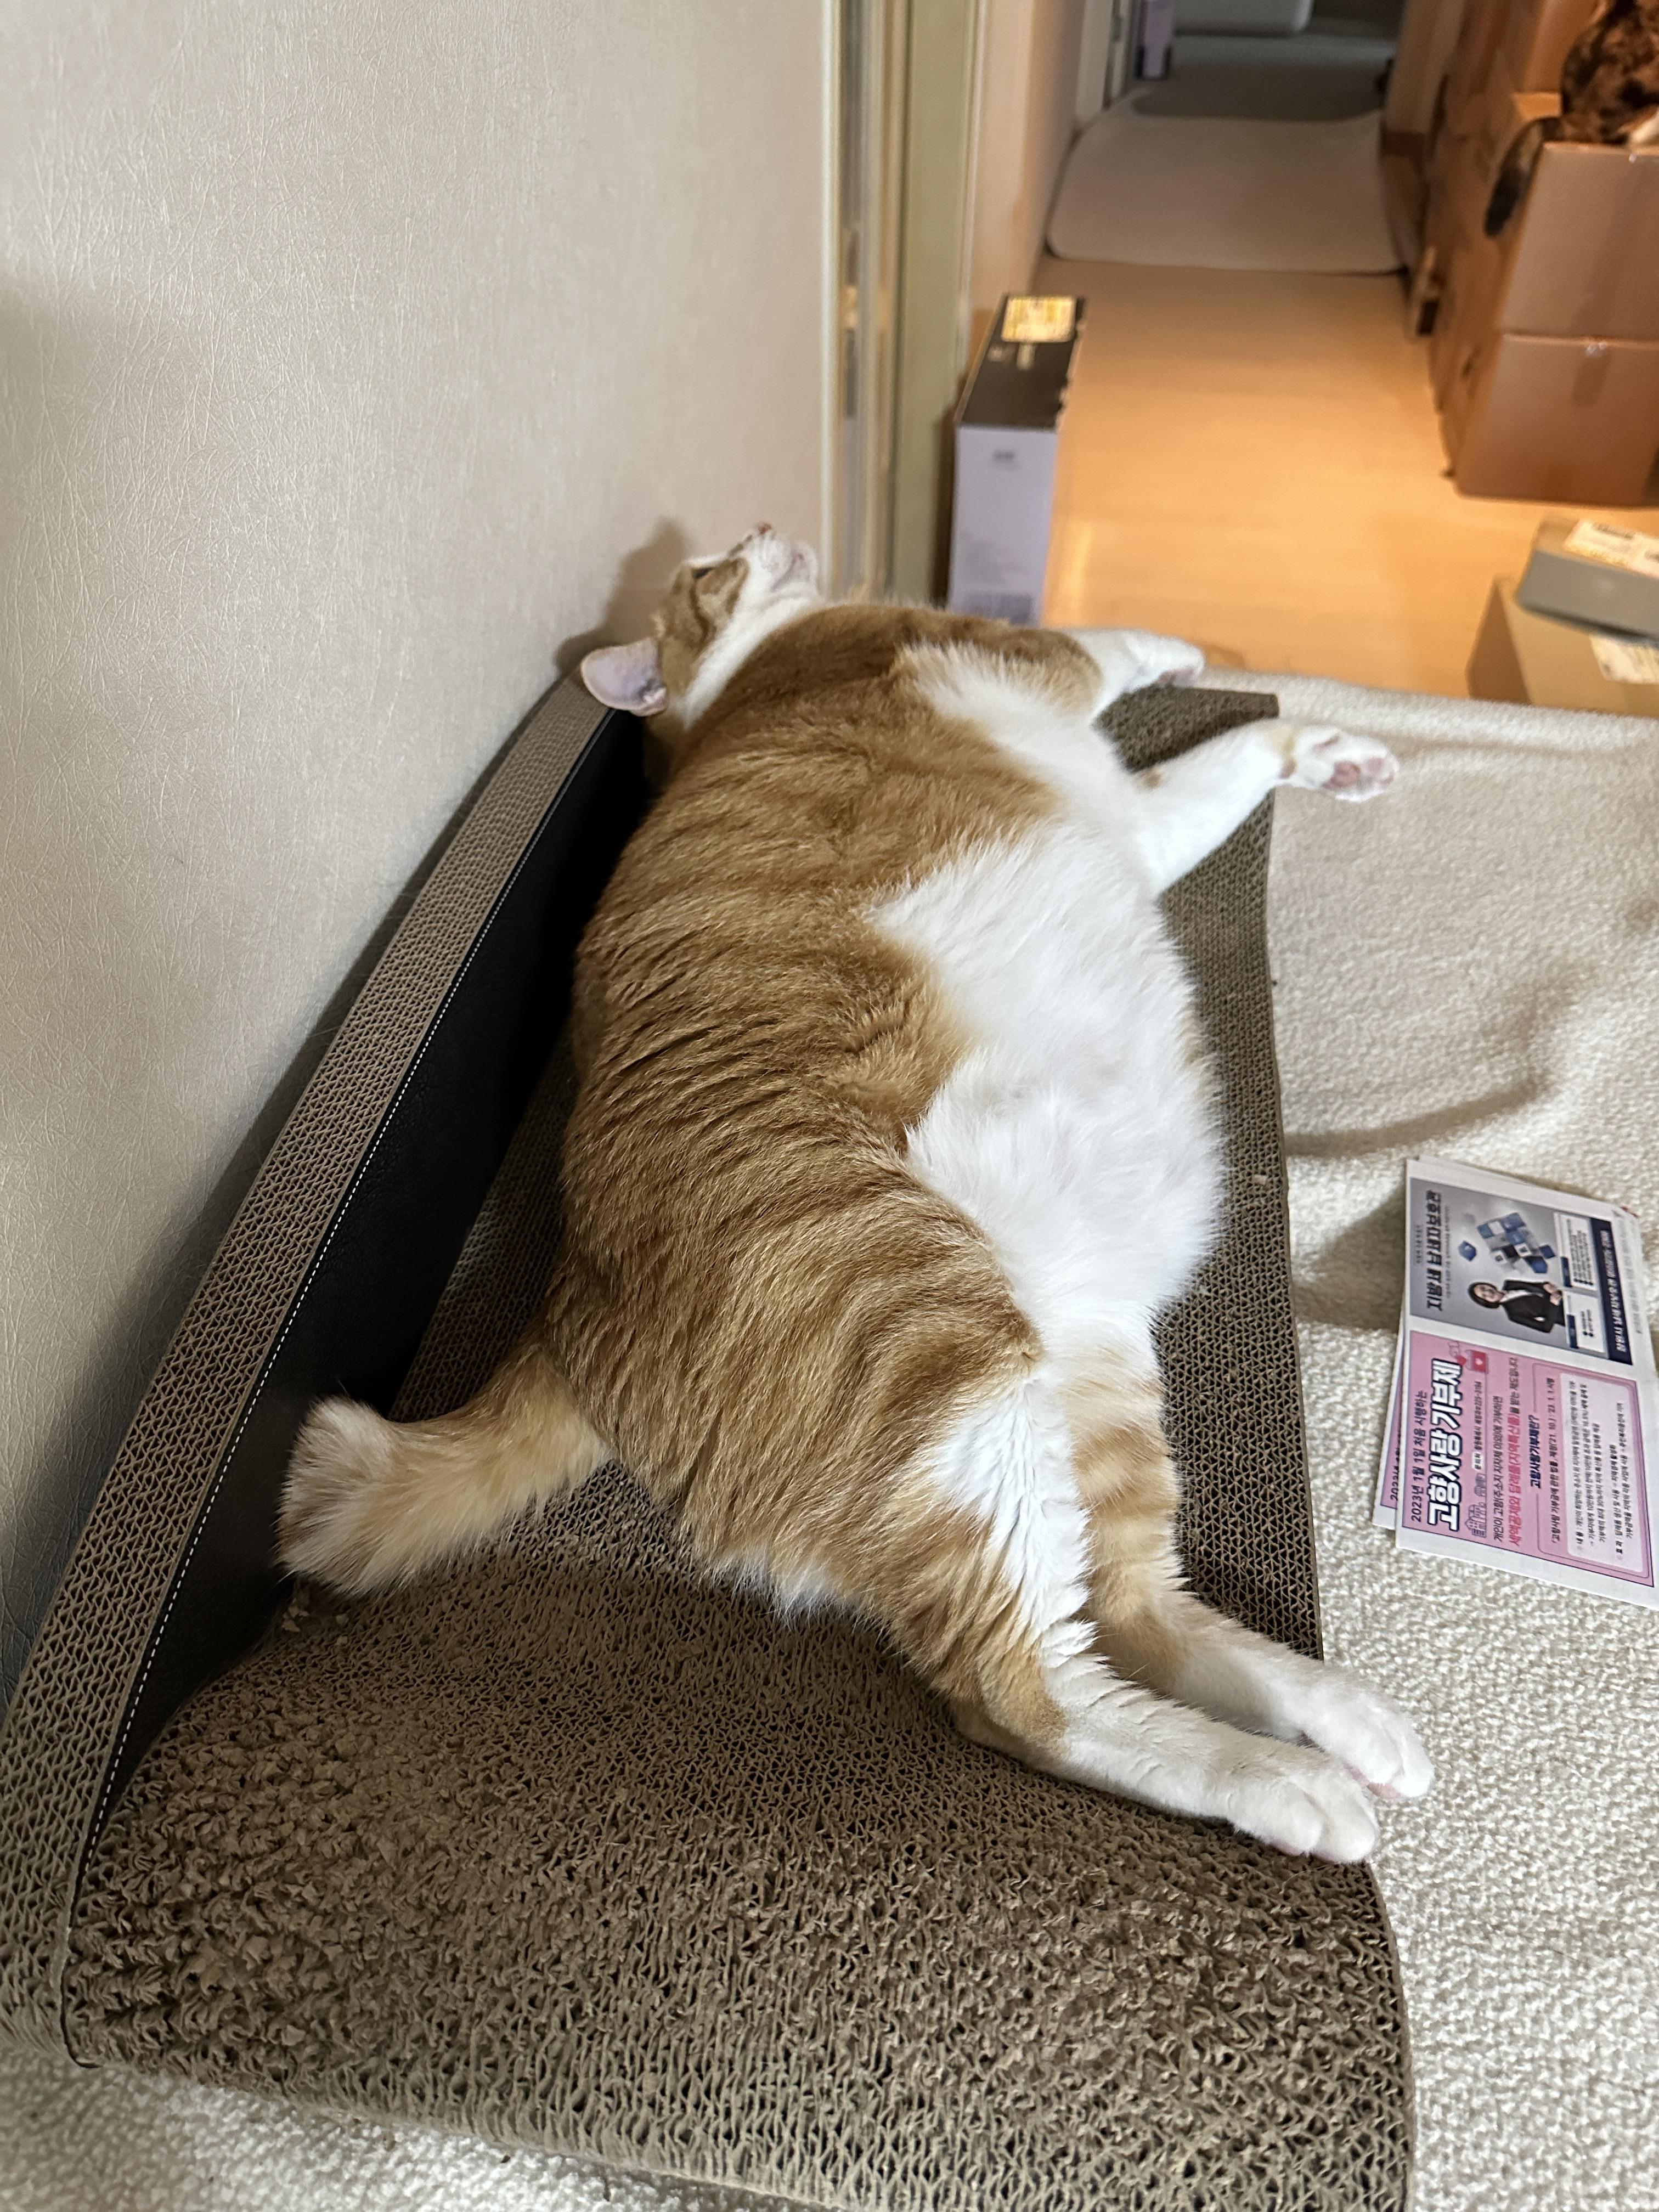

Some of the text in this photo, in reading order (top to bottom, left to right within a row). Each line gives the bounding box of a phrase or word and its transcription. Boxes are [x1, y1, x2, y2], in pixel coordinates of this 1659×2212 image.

[1426, 1268, 1442, 1312] 지방세
[1411, 1390, 1427, 1522] 2023년 1월 1일 처음 시행하는
[1426, 1357, 1463, 1532] 고향사랑 기부제
[1527, 1414, 1541, 1489] 고향사랑기부제란?
[1493, 1516, 1504, 1542] 개인이
[1508, 1496, 1521, 1546] 세액공제와
